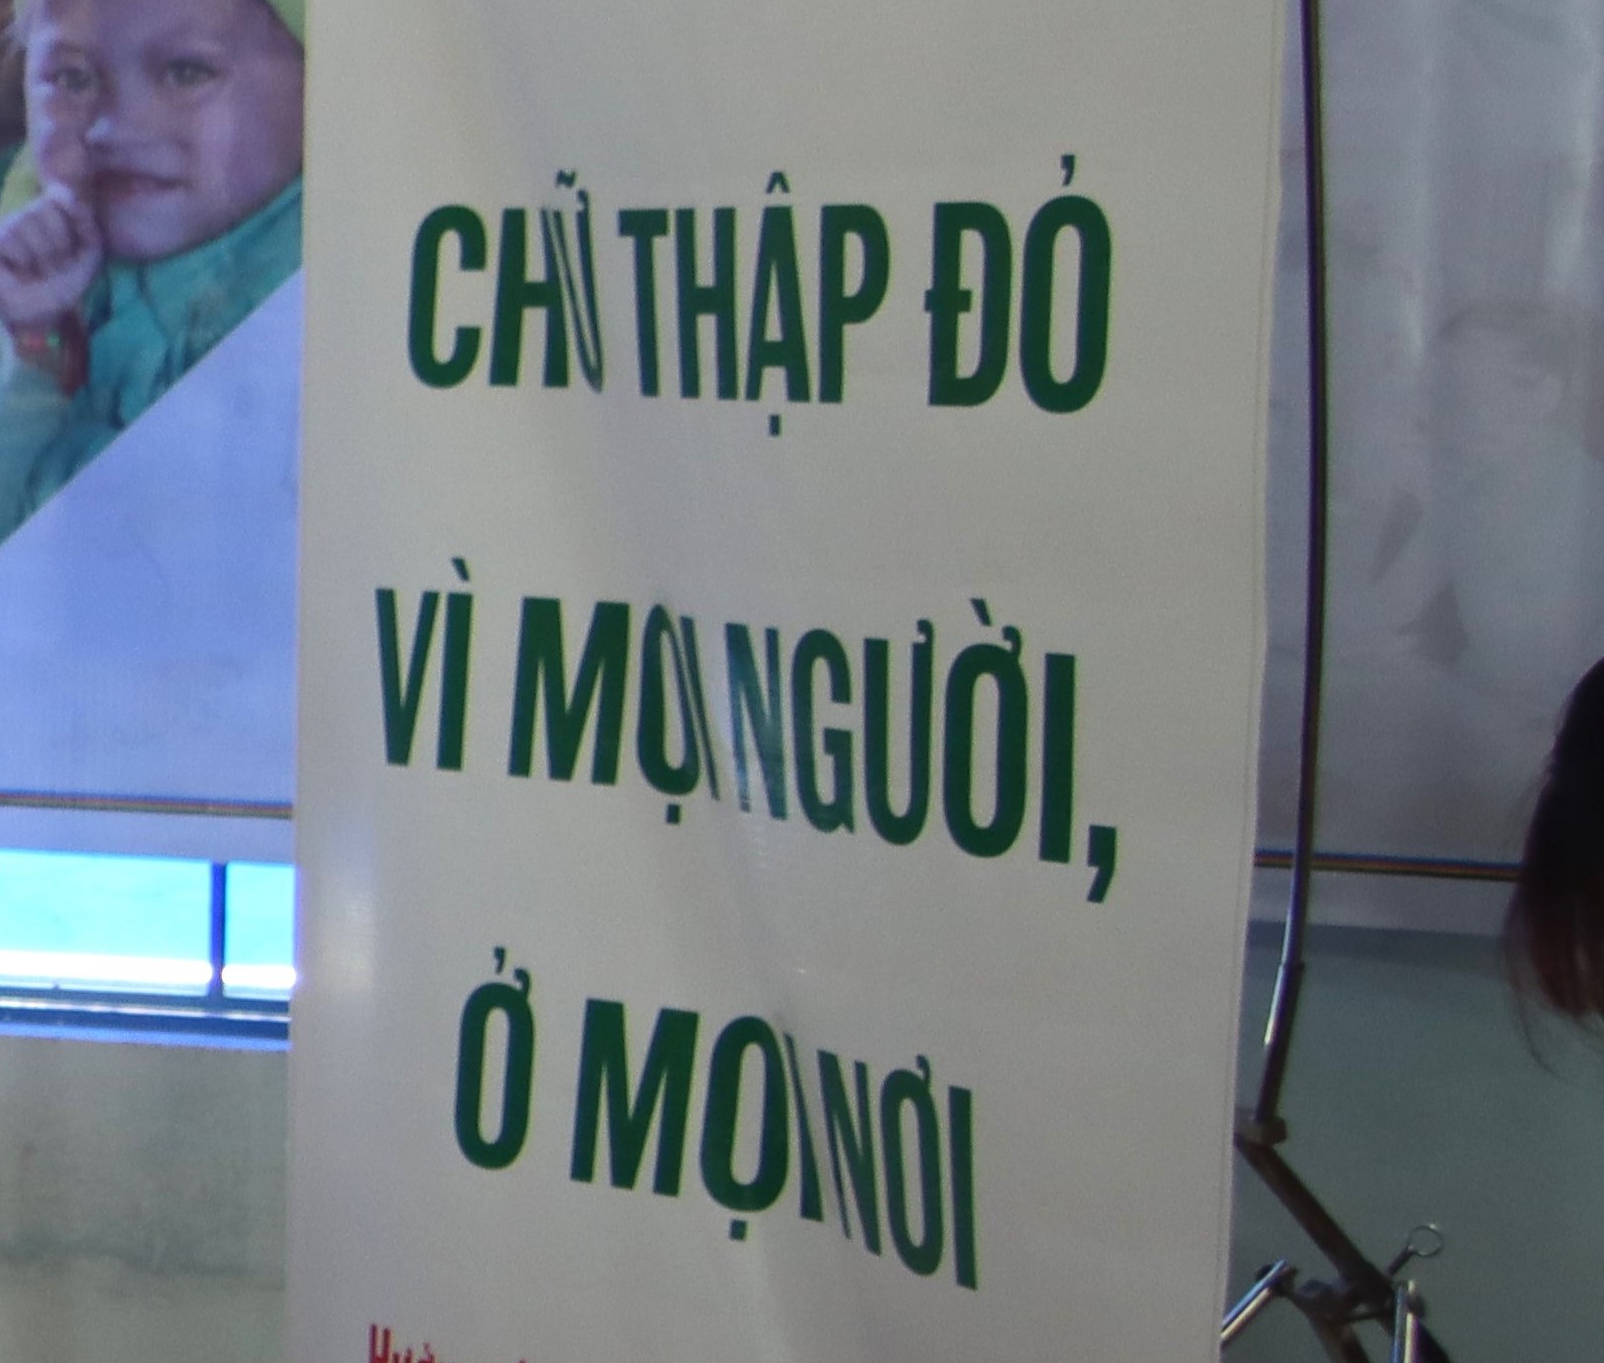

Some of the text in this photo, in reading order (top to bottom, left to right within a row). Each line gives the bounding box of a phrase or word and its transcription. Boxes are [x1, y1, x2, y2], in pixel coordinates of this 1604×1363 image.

[406, 154, 1114, 437] CHỮ THẬP ĐỎ
[374, 556, 1119, 905] VÌ MỌI NGƯỜI,
[452, 946, 980, 1292] Ở MỌI NƠI
